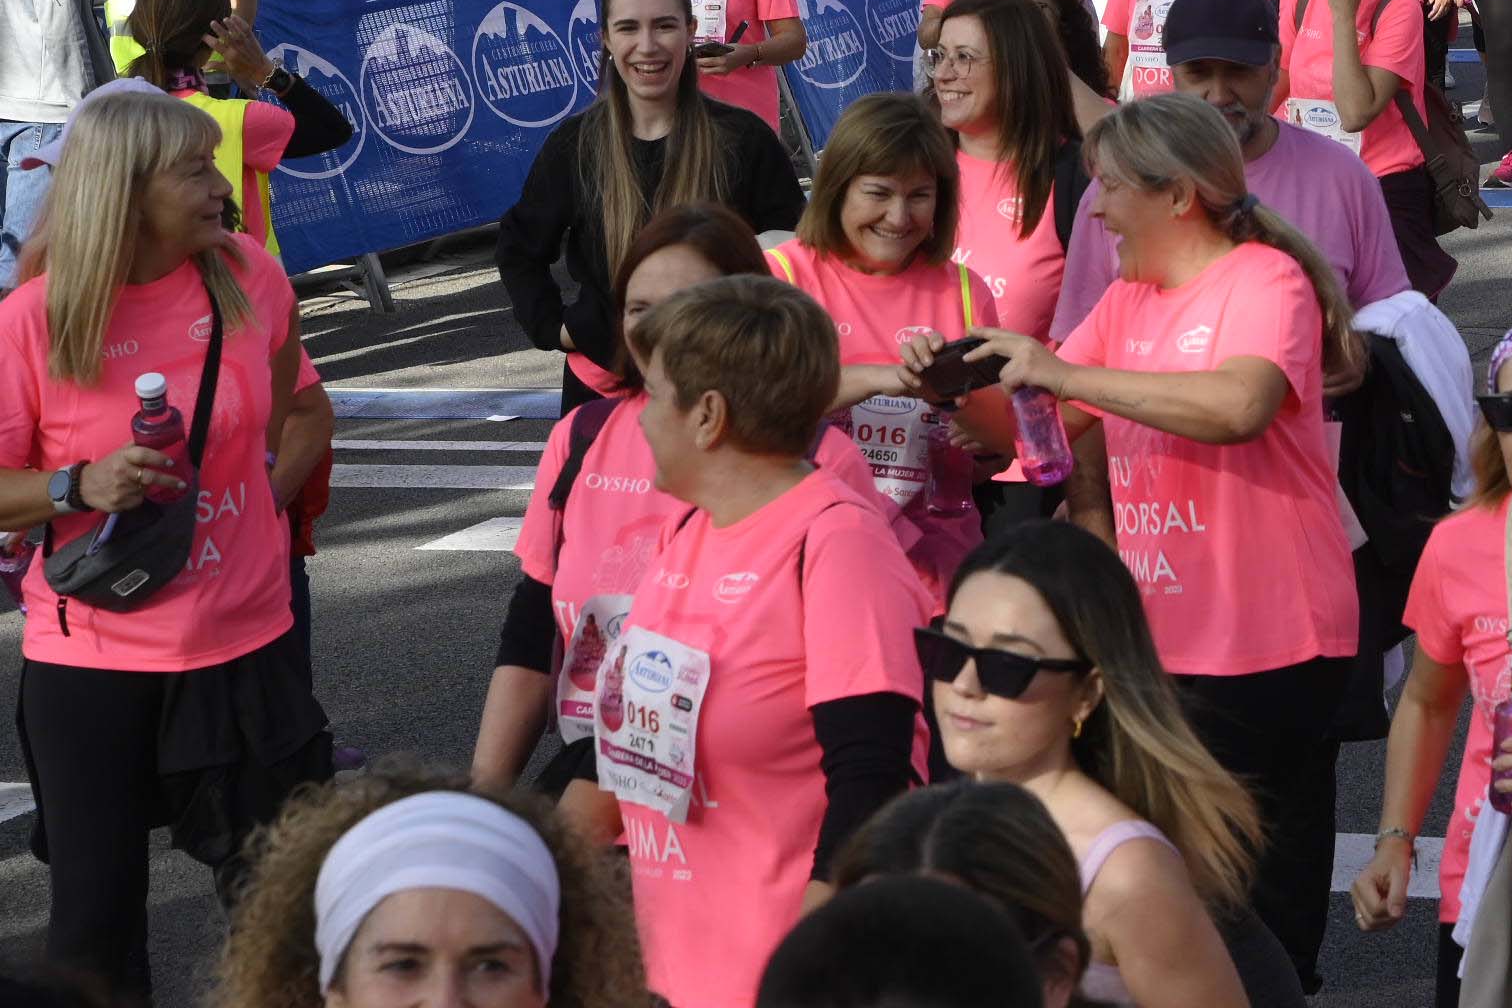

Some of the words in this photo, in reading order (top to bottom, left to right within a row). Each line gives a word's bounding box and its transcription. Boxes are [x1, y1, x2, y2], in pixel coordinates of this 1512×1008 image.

[482, 53, 573, 102] ASTURIANA
[857, 424, 906, 445] 016
[860, 448, 898, 462] 24650
[585, 472, 650, 493] OYSHO
[874, 467, 886, 475] LA
[887, 469, 914, 479] MUJER
[1111, 456, 1131, 487] TU
[1116, 500, 1206, 536] DORSAL
[627, 701, 660, 734] 016
